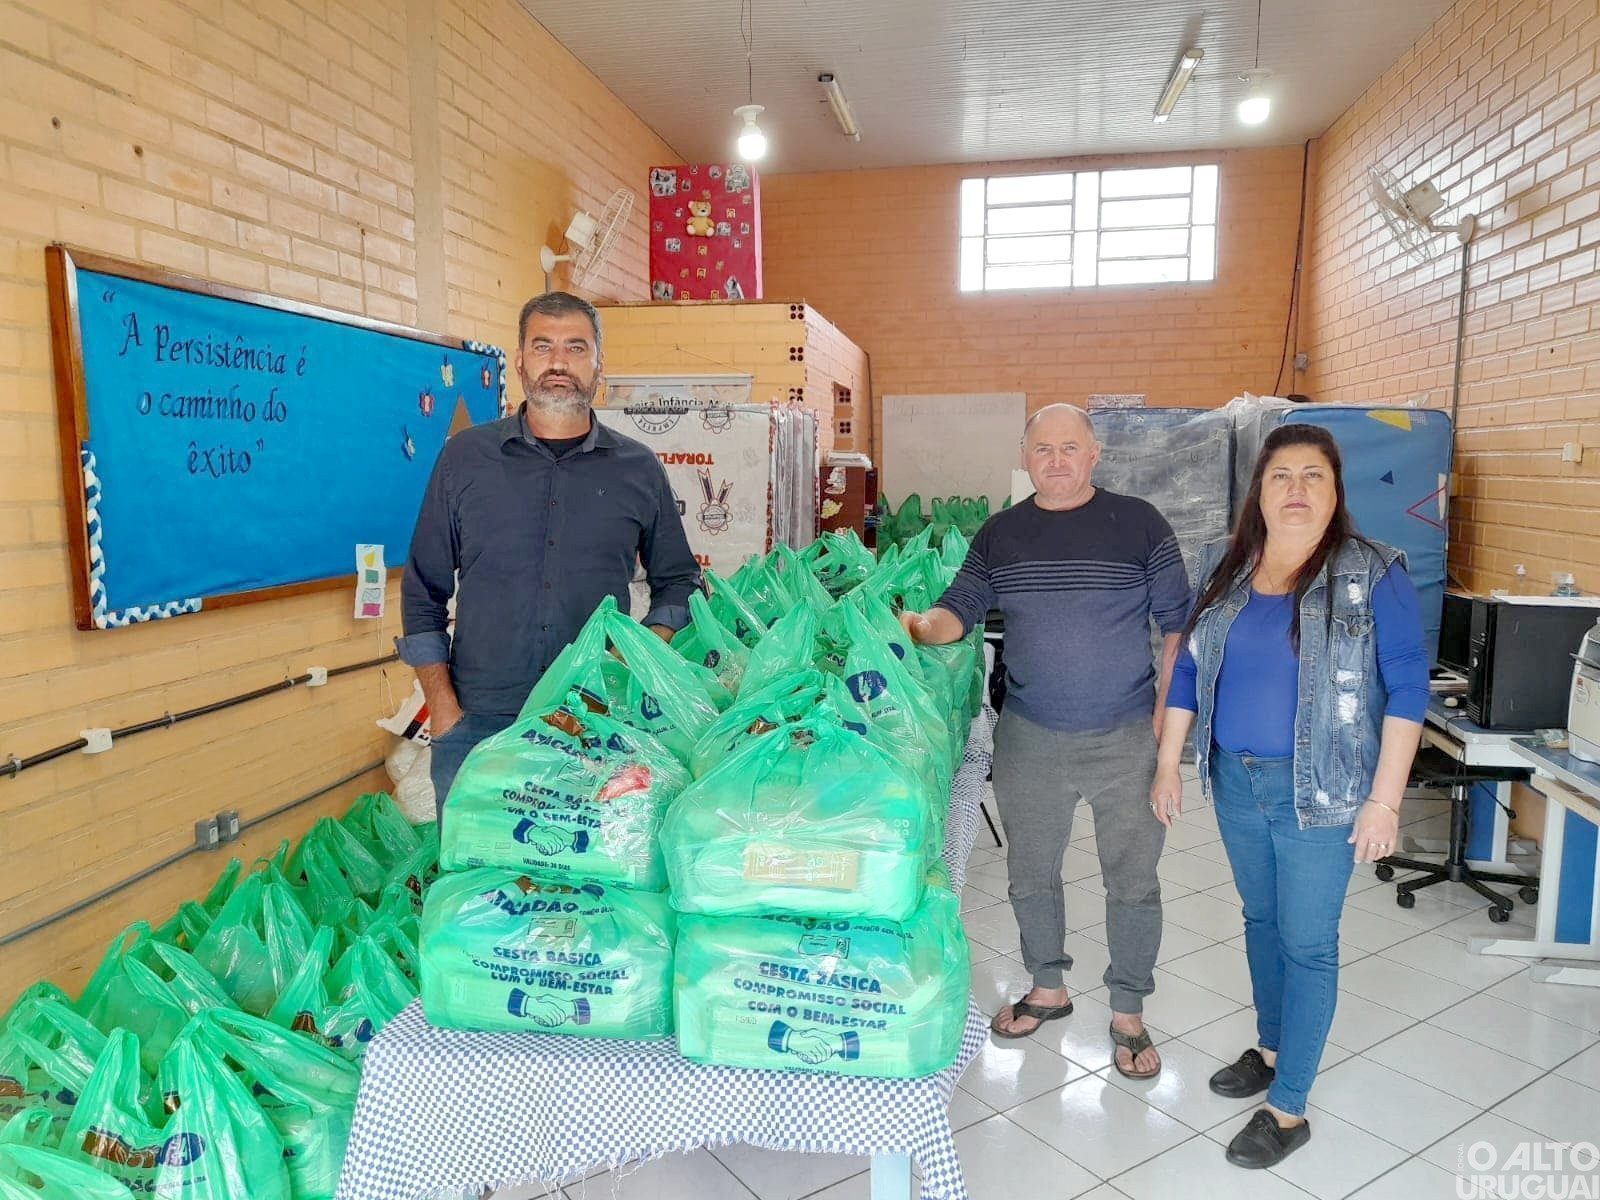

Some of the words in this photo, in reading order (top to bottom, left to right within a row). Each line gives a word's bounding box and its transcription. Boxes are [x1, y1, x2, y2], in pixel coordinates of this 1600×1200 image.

[153, 323, 287, 376] Persistência
[296, 345, 307, 377] é
[159, 384, 256, 423] caminho
[261, 387, 287, 423] do
[656, 452, 714, 466] TORAFL
[493, 946, 540, 963] CESTA
[472, 958, 573, 981] COMPROMISSO
[577, 968, 630, 982] SOCIAL
[758, 961, 810, 984] CESTA
[733, 977, 847, 1007] COMPROMISSO
[851, 997, 908, 1016] SOCIAL
[748, 1000, 783, 1016] COM
[786, 1005, 799, 1019] O
[803, 1009, 888, 1031] BEM-ESTAR
